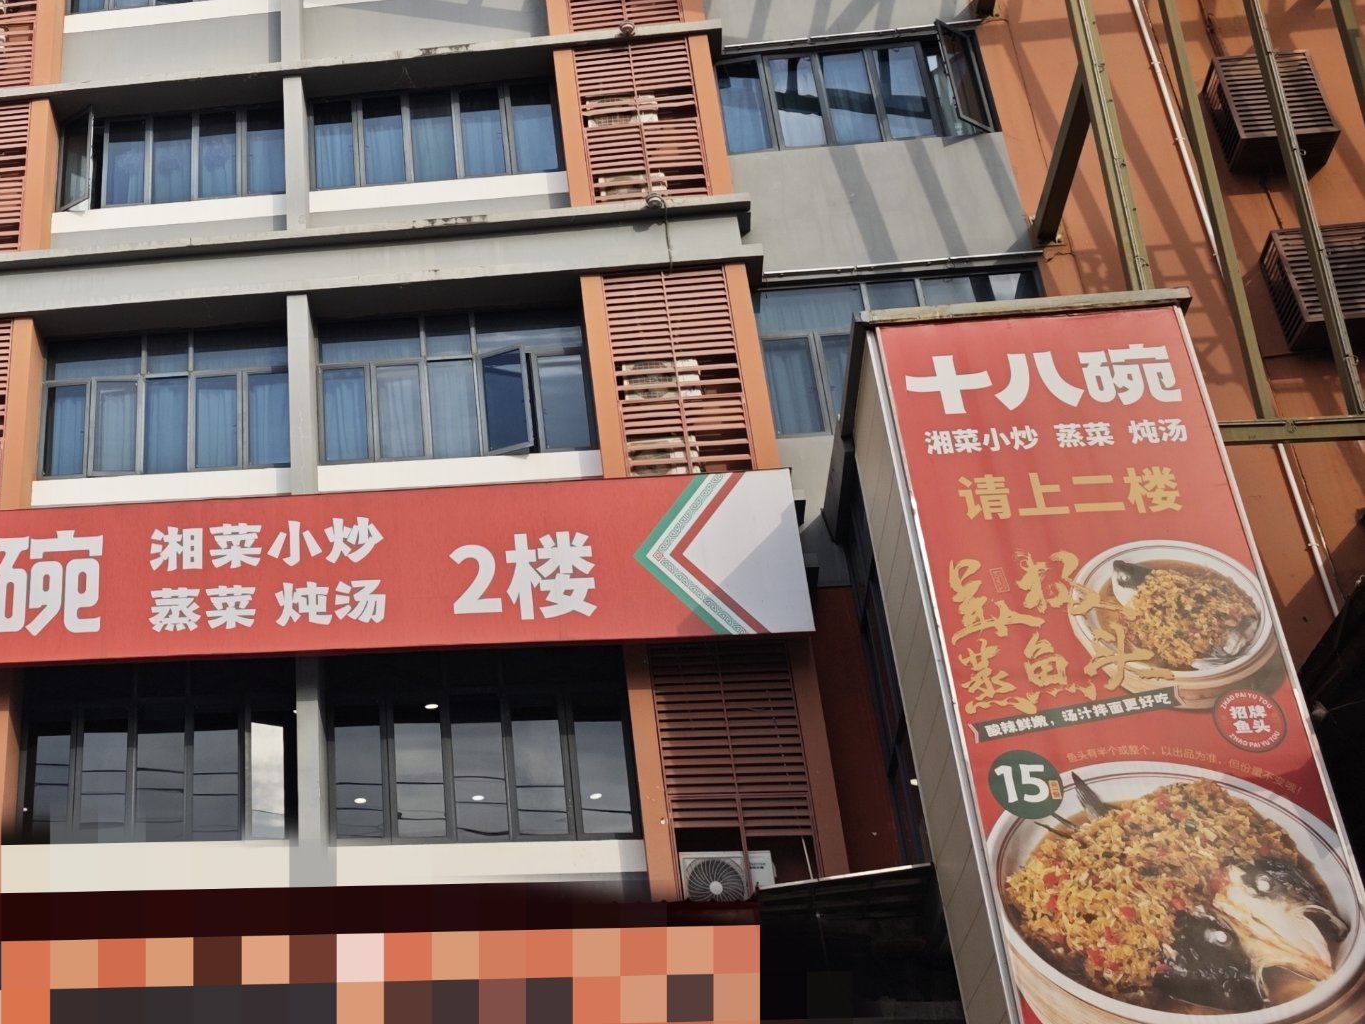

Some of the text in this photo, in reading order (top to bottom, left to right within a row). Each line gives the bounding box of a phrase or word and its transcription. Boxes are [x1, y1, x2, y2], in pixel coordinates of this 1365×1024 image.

[906, 344, 1183, 415] 十八碗
[924, 418, 1189, 456] 湘菜小炒 蒸菜 炖汤
[958, 466, 1184, 522] 请上二楼
[150, 517, 384, 573] 湘菜小炒
[450, 531, 598, 621] 2楼
[149, 580, 387, 634] 蒸菜 炖汤
[1229, 704, 1268, 719] 招牌
[1233, 718, 1271, 734] 鱼头
[995, 764, 1050, 804] 15
